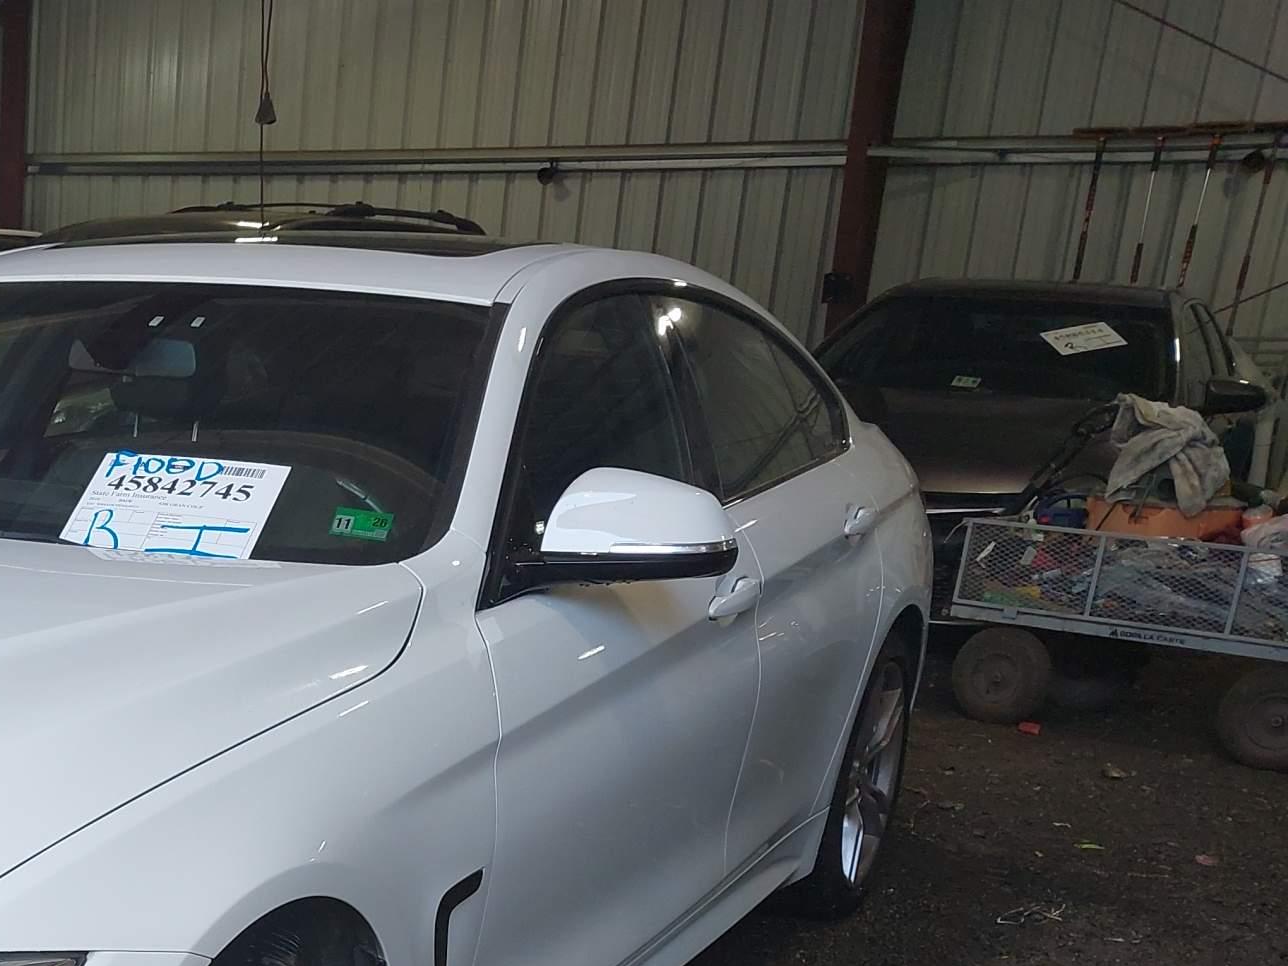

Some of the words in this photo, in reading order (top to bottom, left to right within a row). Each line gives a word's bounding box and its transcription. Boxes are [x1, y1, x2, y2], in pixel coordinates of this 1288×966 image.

[107, 474, 254, 502] 45842745
[132, 491, 167, 501] Insurance
[335, 517, 351, 530] 11
